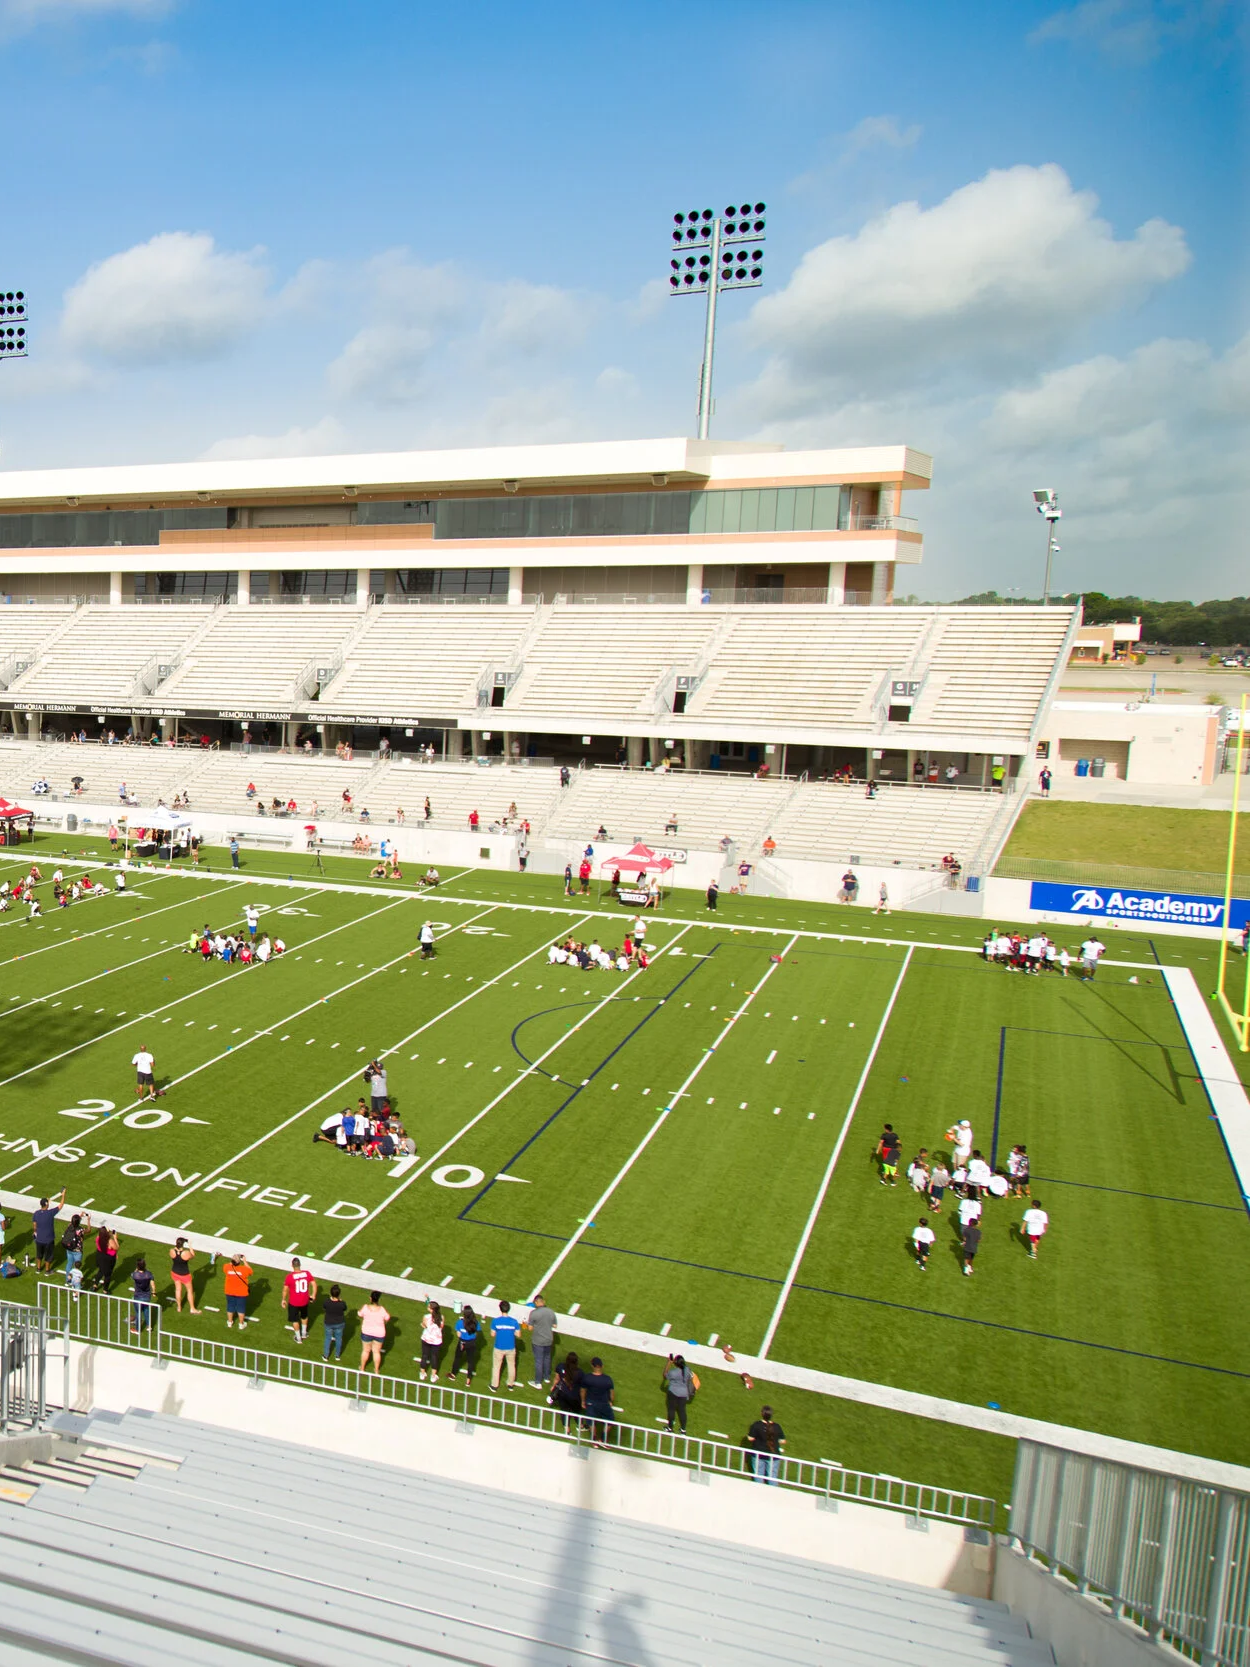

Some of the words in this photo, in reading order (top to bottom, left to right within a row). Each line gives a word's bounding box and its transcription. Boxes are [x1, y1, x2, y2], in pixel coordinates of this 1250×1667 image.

[219, 711, 254, 719] MEMORIAL
[256, 712, 291, 720] HERMANN
[327, 715, 355, 723] Healthcare
[356, 716, 378, 724] Provider
[1106, 892, 1224, 922] Academy
[58, 1099, 173, 1129] 20
[387, 1155, 485, 1188] 10
[204, 1177, 369, 1220] FIELD
[295, 1279, 308, 1293] 10
